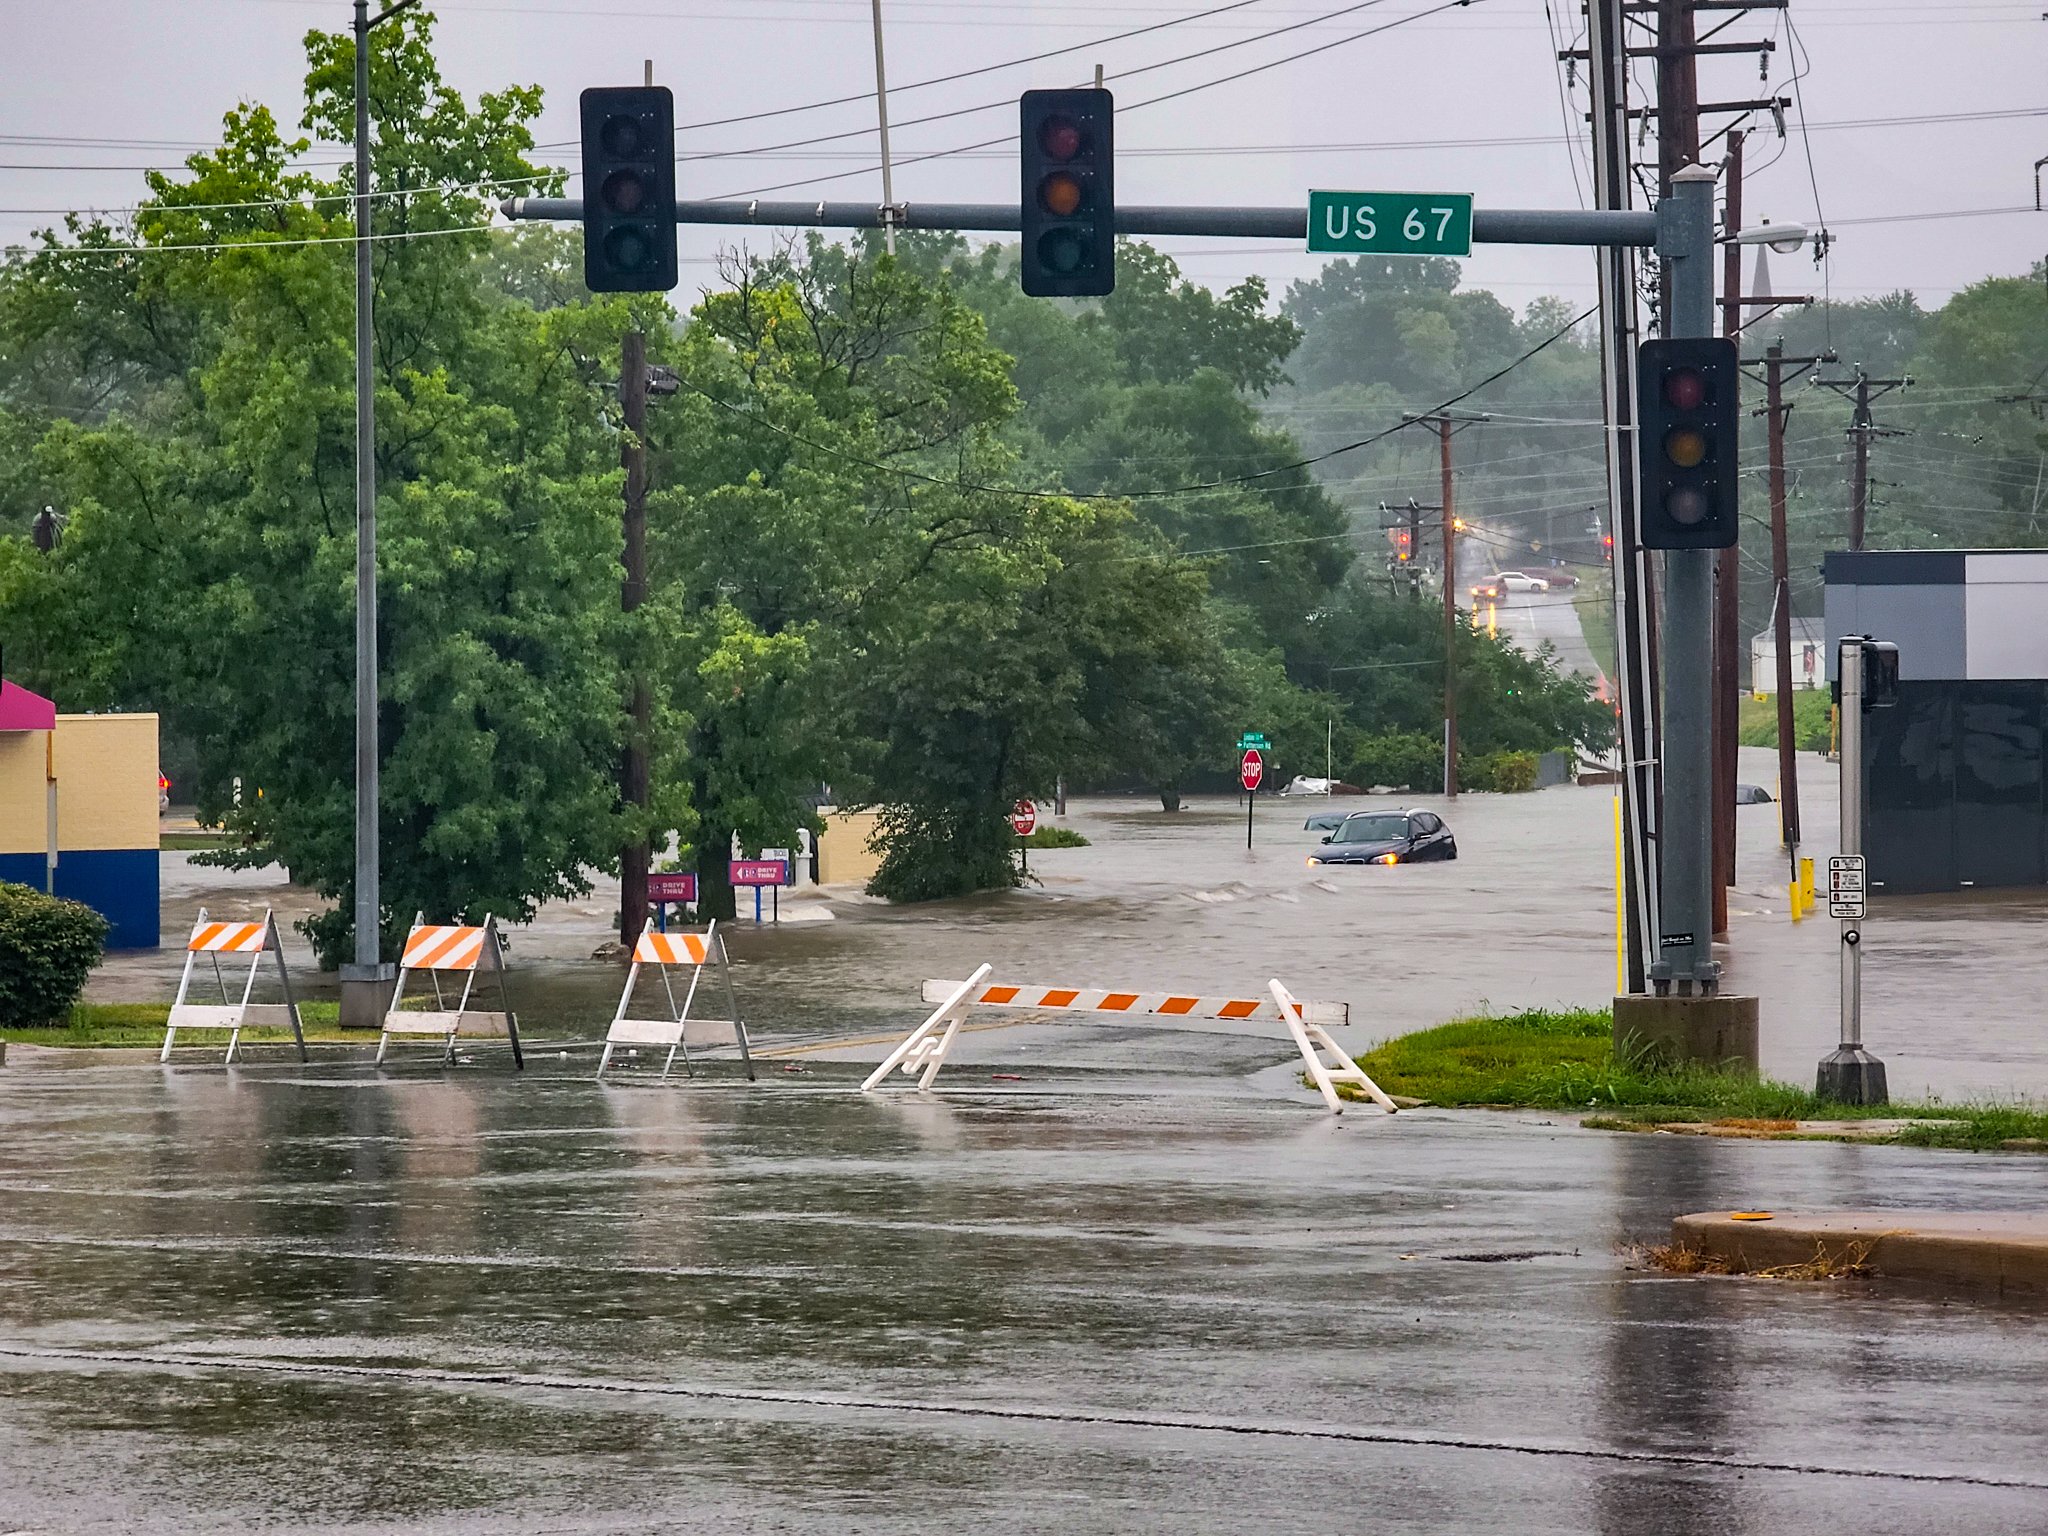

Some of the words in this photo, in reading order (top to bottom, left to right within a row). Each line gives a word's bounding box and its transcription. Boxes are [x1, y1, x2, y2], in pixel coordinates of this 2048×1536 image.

[1326, 205, 1377, 240] US
[1403, 207, 1454, 242] 67
[1243, 762, 1261, 777] STOP
